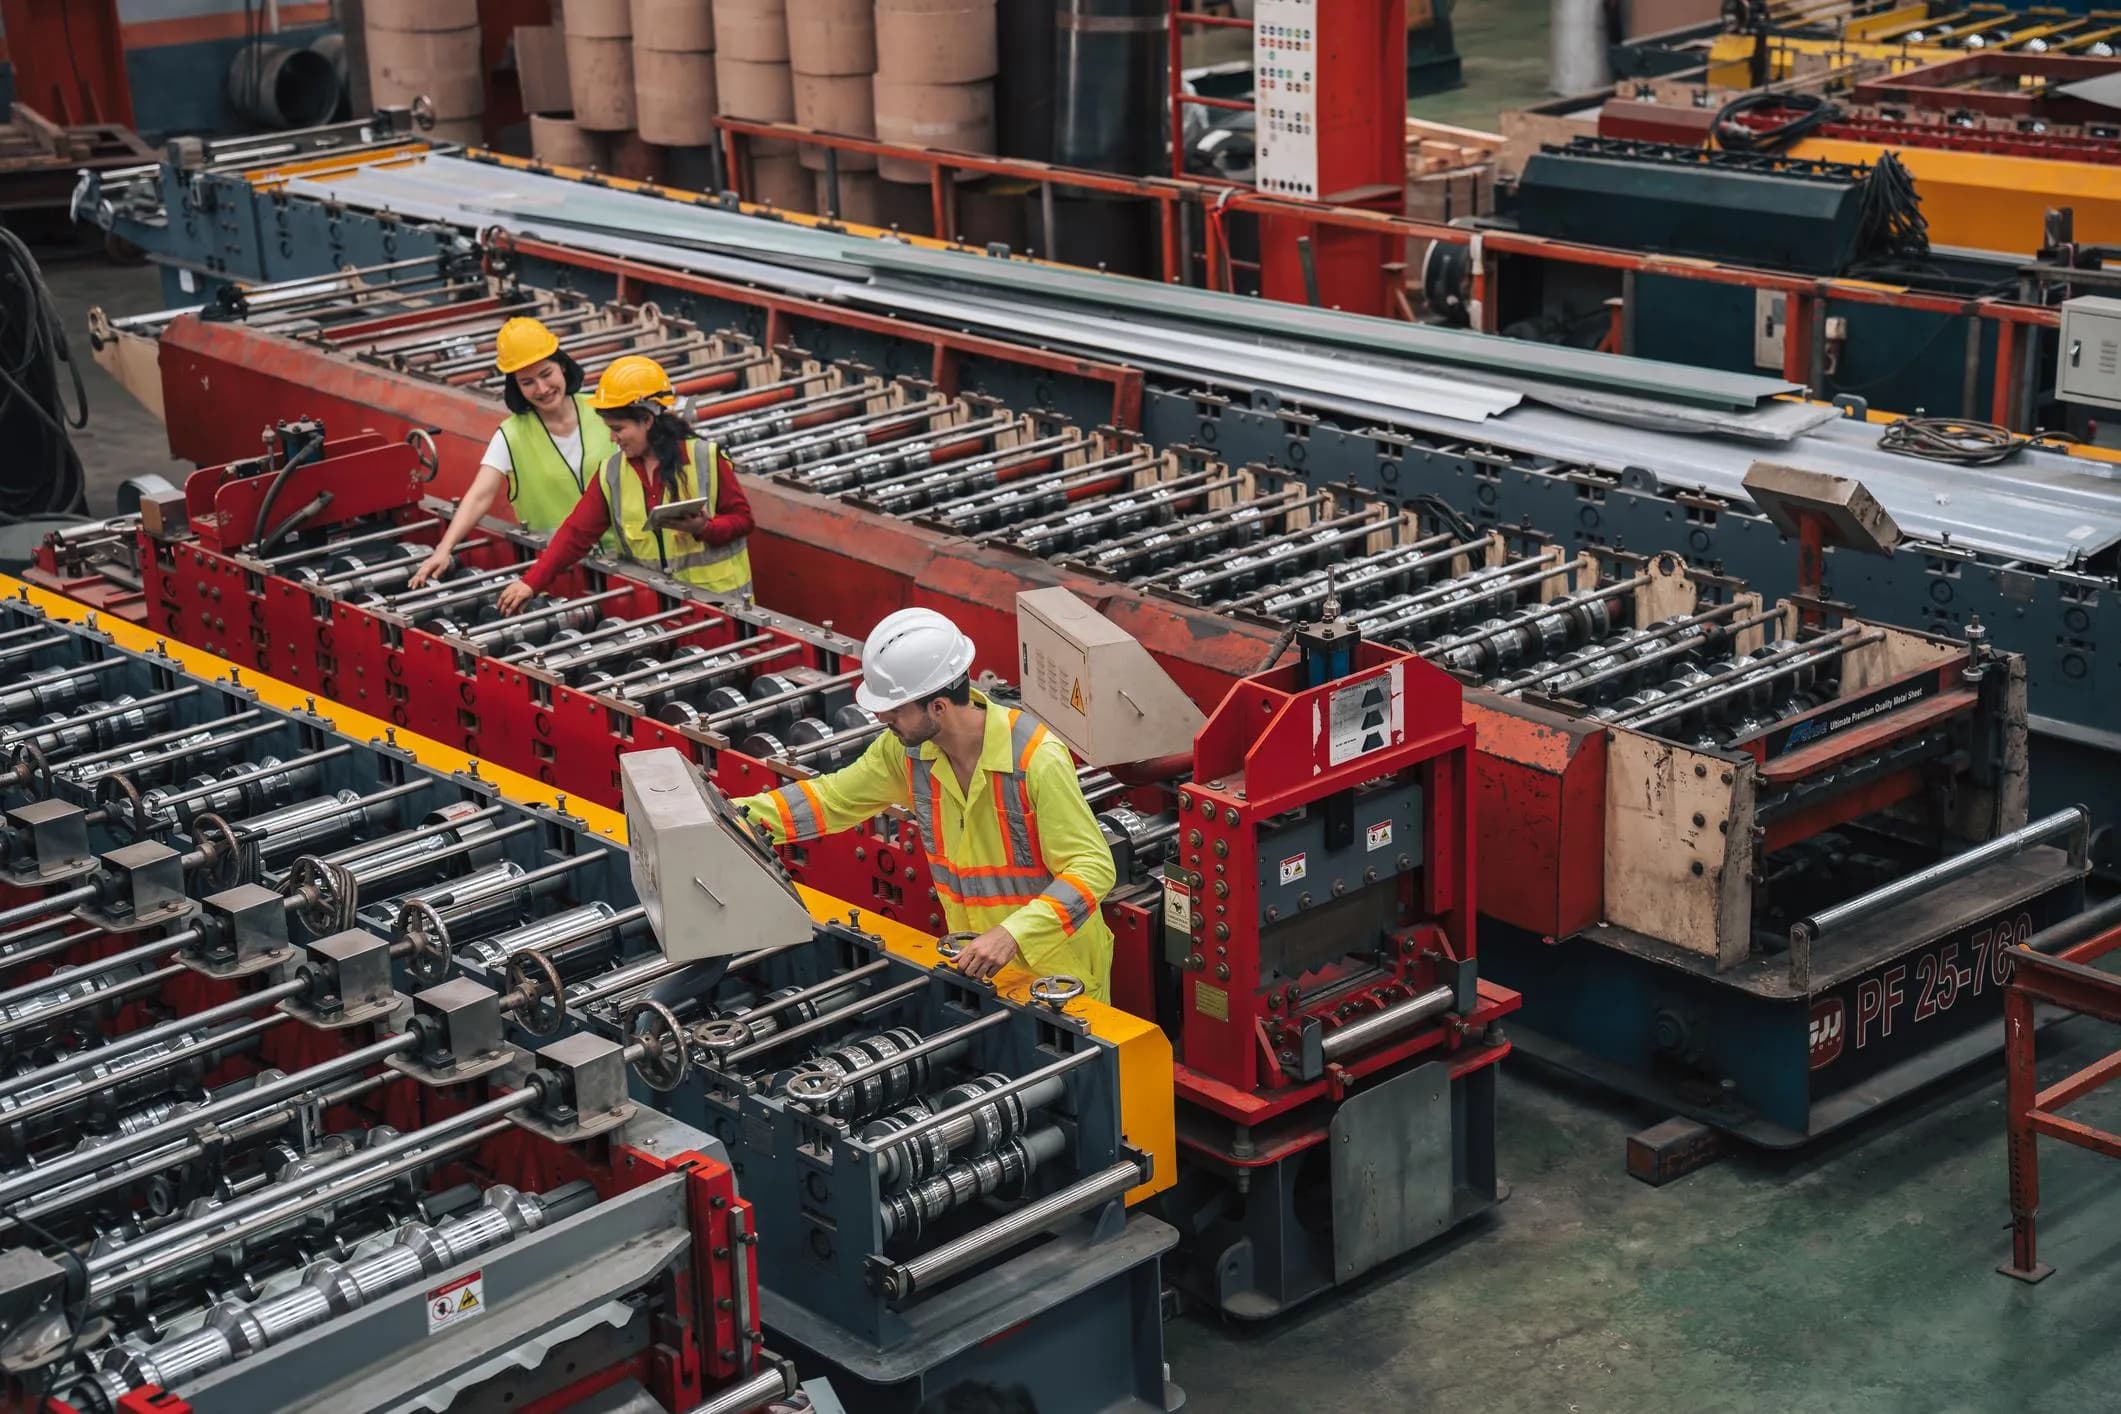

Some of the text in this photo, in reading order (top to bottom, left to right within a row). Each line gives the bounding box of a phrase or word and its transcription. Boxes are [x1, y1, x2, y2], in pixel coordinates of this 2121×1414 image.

[1830, 688, 1922, 730] Ultimate Premium Quality Metal Sheet
[1857, 965, 1905, 1048] PF
